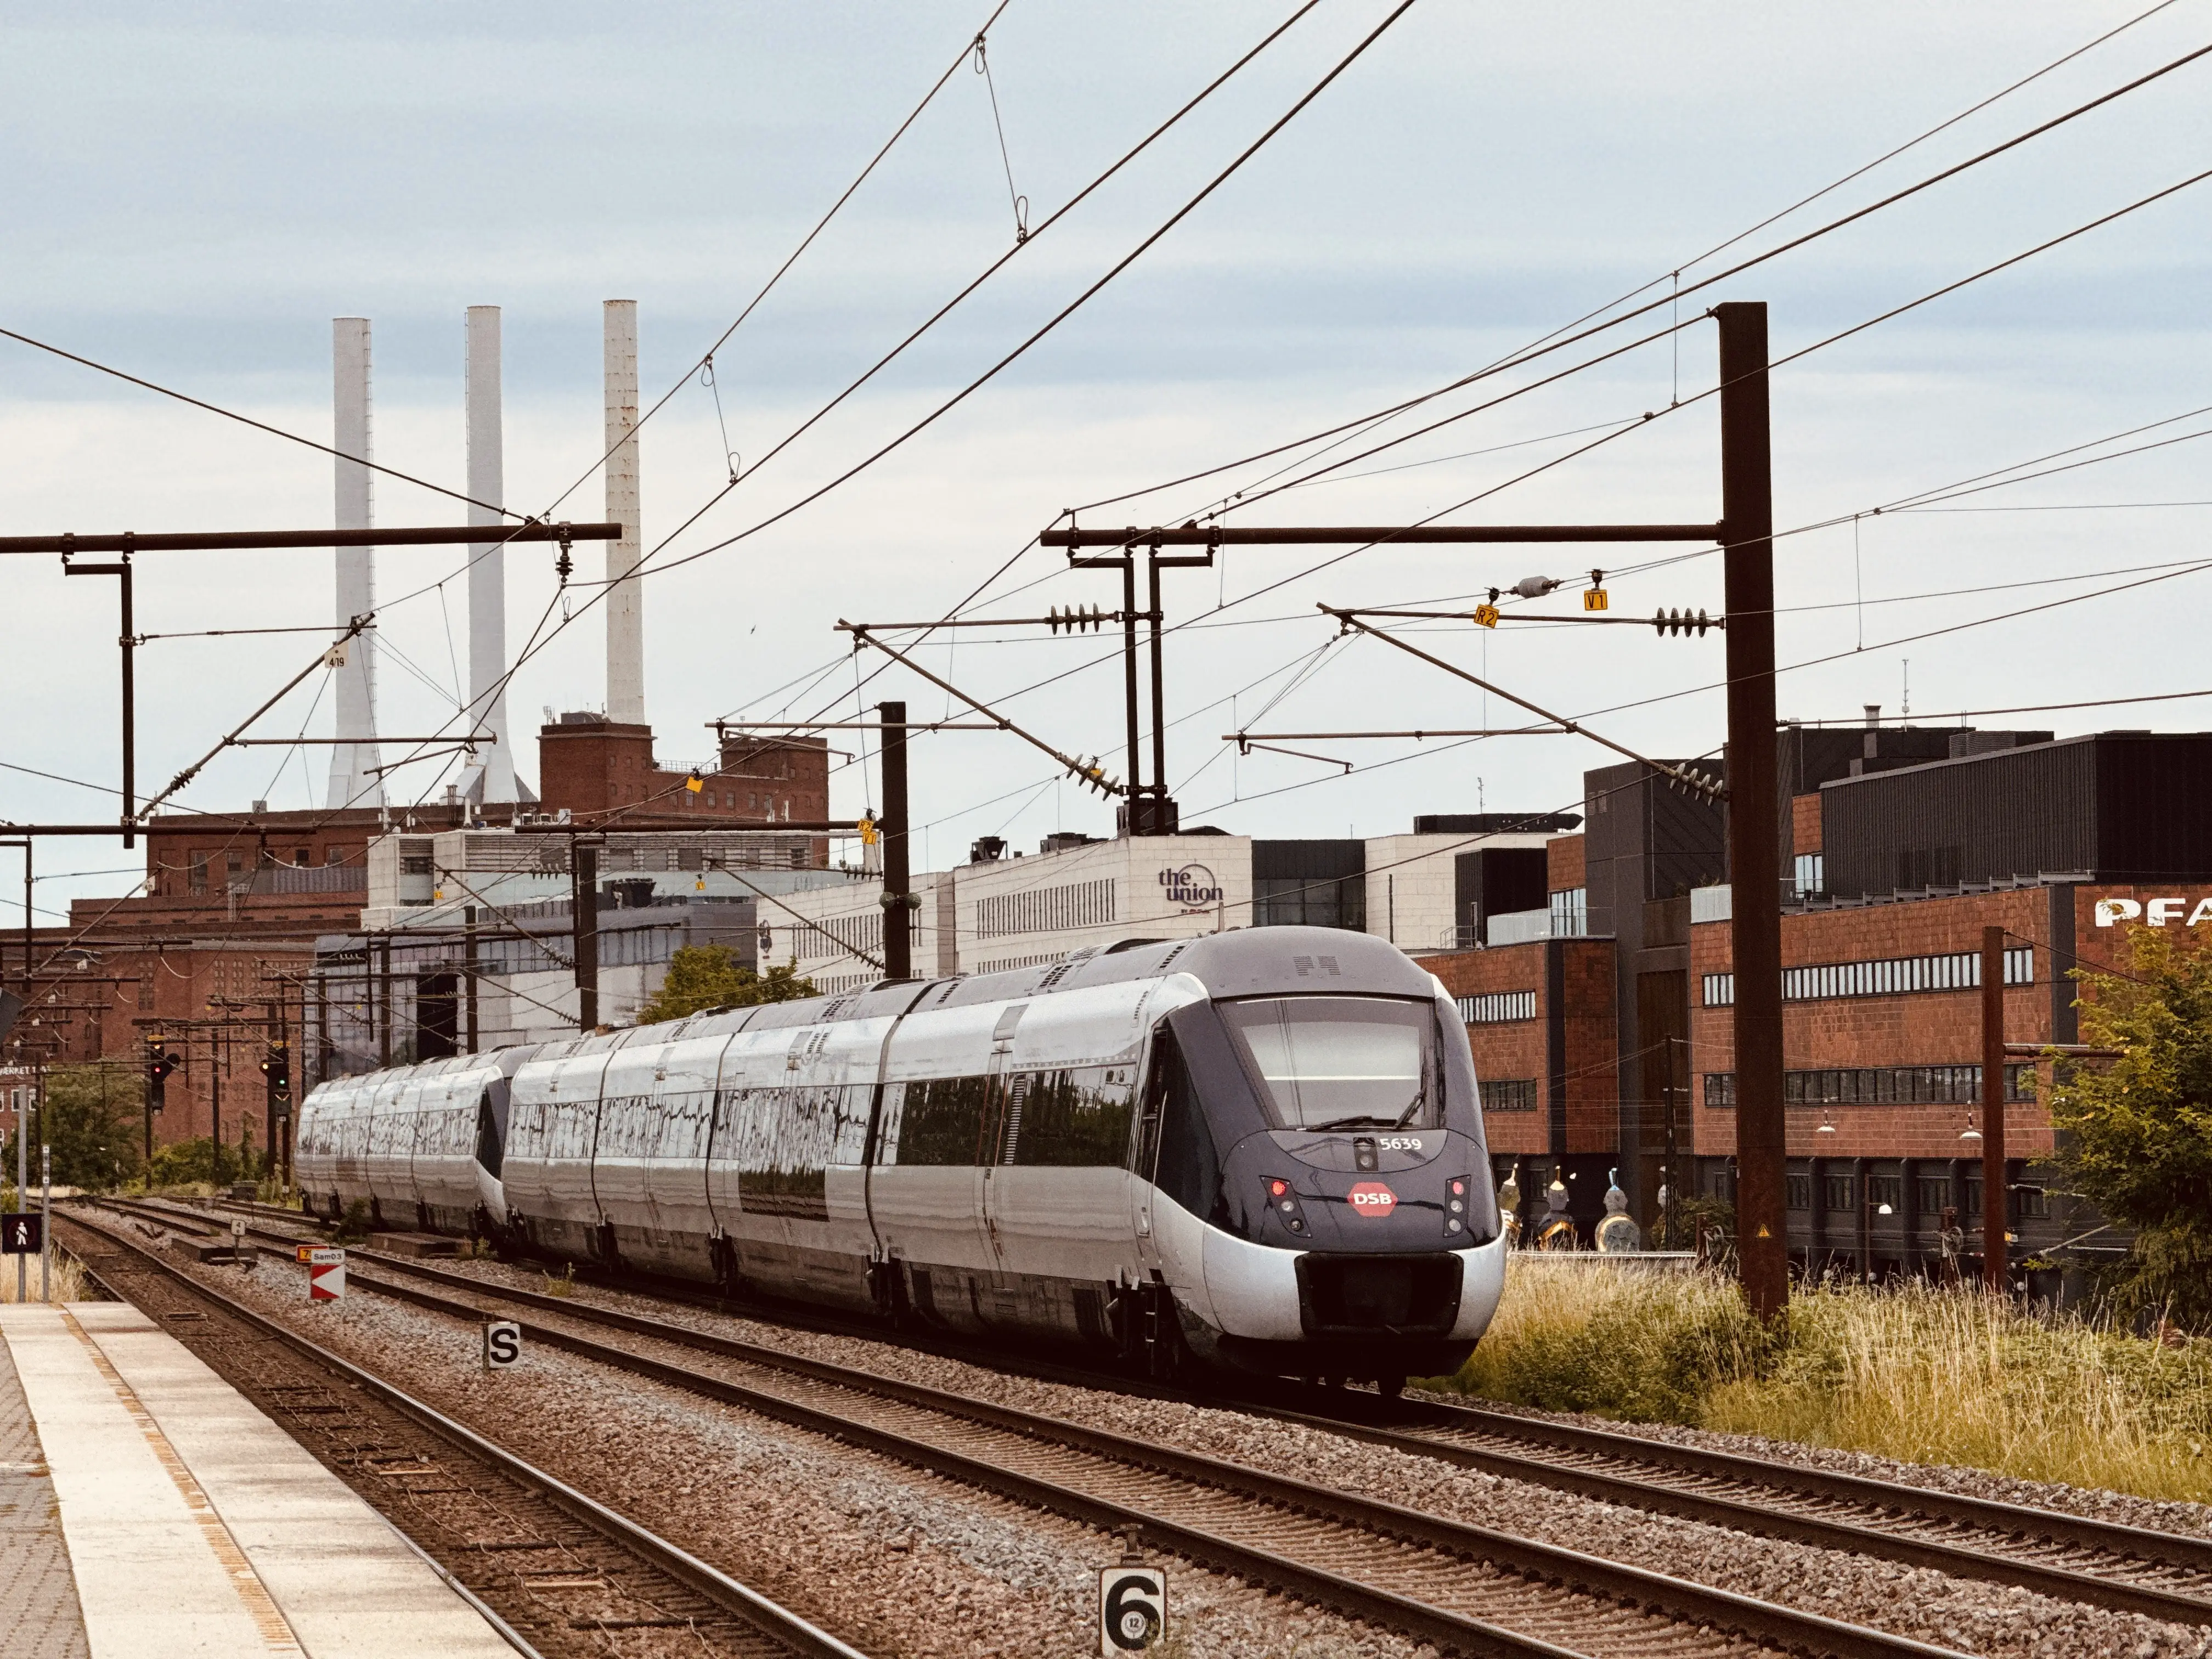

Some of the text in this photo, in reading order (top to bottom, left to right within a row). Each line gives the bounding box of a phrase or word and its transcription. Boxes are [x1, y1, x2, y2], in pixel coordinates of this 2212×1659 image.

[1587, 594, 1604, 609] V1
[1476, 609, 1496, 626] R2
[329, 657, 345, 667] 4/19
[859, 821, 871, 831] R2
[865, 834, 874, 843] V1
[1159, 868, 1191, 886] the
[1166, 883, 1224, 901] union
[1379, 1138, 1422, 1150] 5639
[1353, 1193, 1392, 1205] DSB
[490, 1328, 519, 1364] S
[1105, 1575, 1161, 1651] 6
[1128, 1617, 1139, 1628] 12
